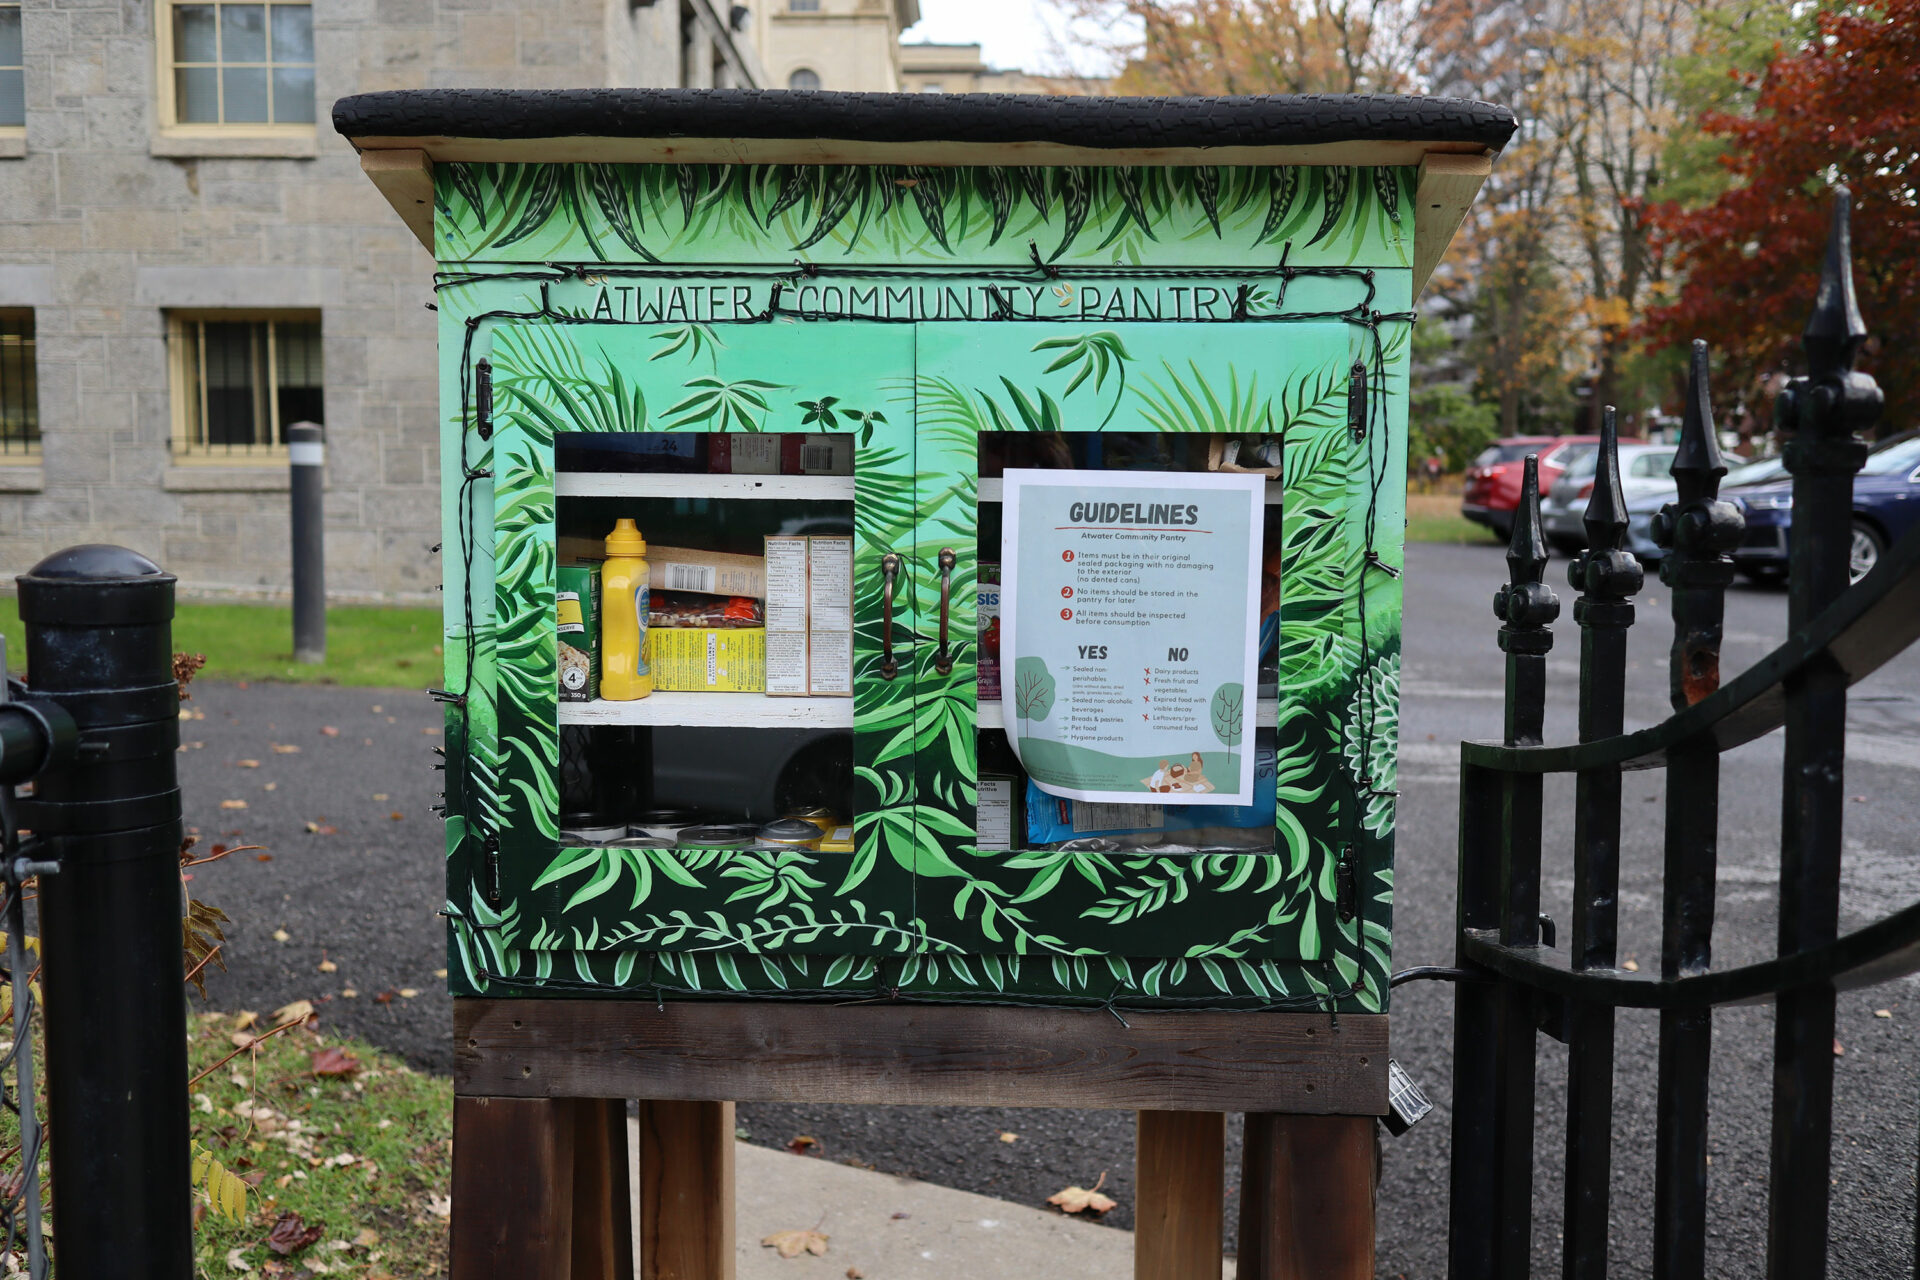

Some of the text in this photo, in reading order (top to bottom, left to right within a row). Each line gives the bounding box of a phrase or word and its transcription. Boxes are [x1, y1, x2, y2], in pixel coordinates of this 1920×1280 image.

[593, 286, 1243, 321] ATWATER COMMUNITY PANTRY
[1069, 502, 1198, 525] GUIDELINES
[1081, 532, 1186, 542] Atwater Community Pantry
[1078, 552, 1099, 560] Items
[1162, 554, 1190, 562] original
[1104, 561, 1144, 570] packaging
[1176, 562, 1214, 571] damaging
[1120, 576, 1140, 584] cans)
[1148, 612, 1186, 620] inspected
[1104, 619, 1150, 627] consumption
[1078, 645, 1108, 660] YES
[1168, 648, 1189, 662] NO
[568, 672, 576, 684] 4
[1072, 706, 1104, 714] beverages
